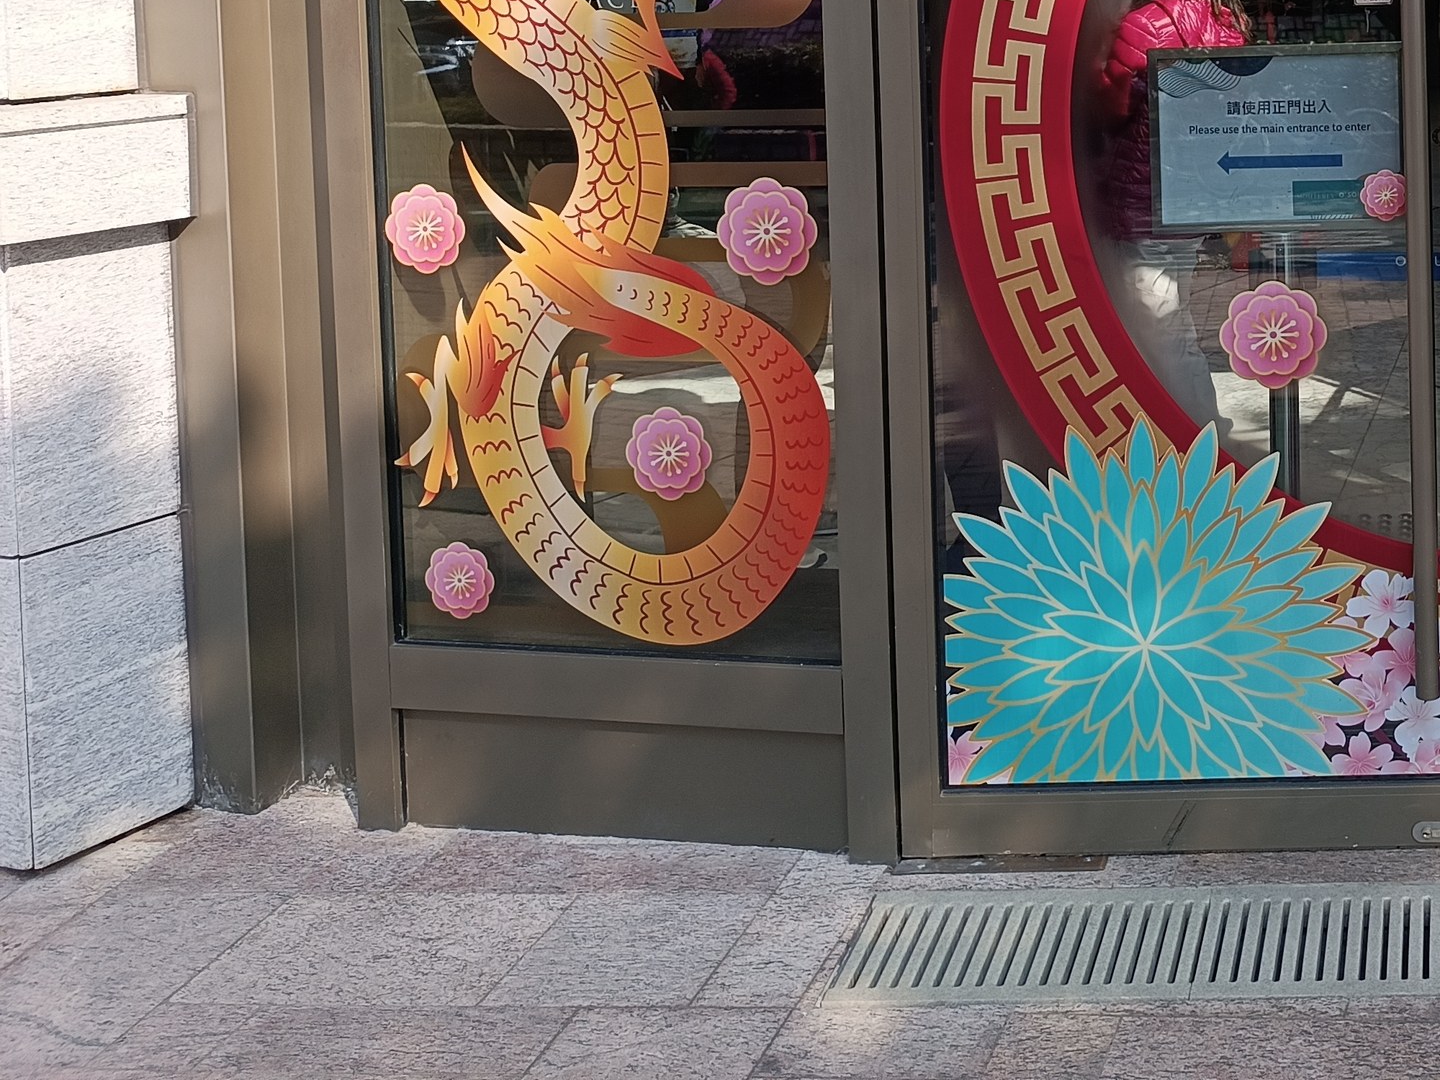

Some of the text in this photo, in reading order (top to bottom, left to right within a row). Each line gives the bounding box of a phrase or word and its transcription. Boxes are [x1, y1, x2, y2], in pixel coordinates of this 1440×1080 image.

[1226, 99, 1332, 116] 請使用正門出入
[1189, 123, 1371, 135] Please use the main entrance to enter
